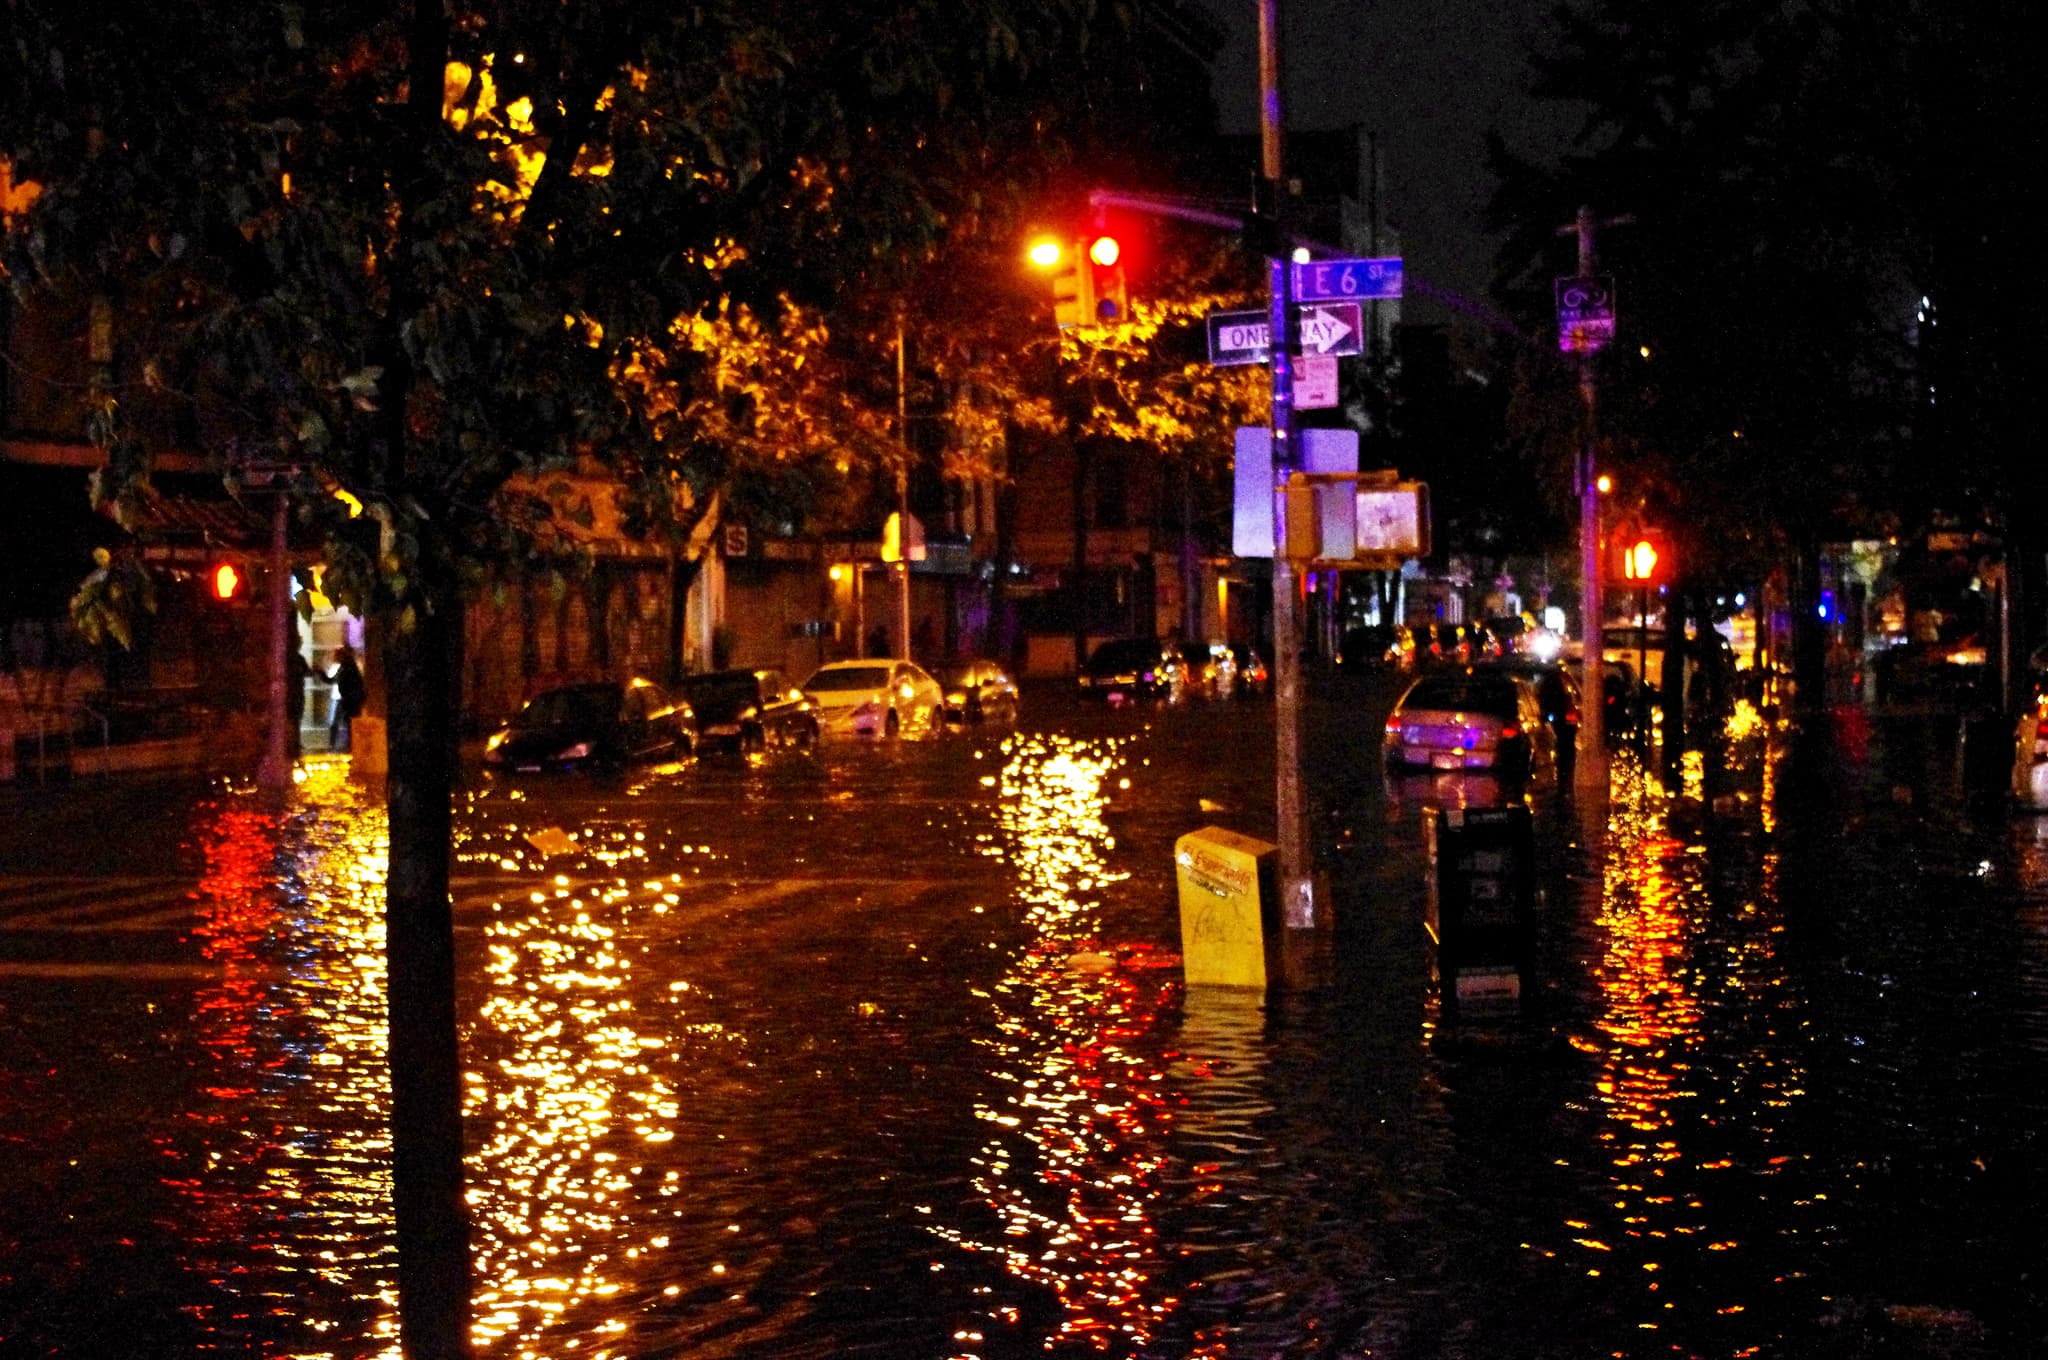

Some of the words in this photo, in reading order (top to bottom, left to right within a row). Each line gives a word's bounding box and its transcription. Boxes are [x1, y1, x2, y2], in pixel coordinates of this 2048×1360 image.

[1316, 266, 1330, 294] E
[1341, 266, 1357, 294] 6
[1231, 326, 1269, 347] ONE
